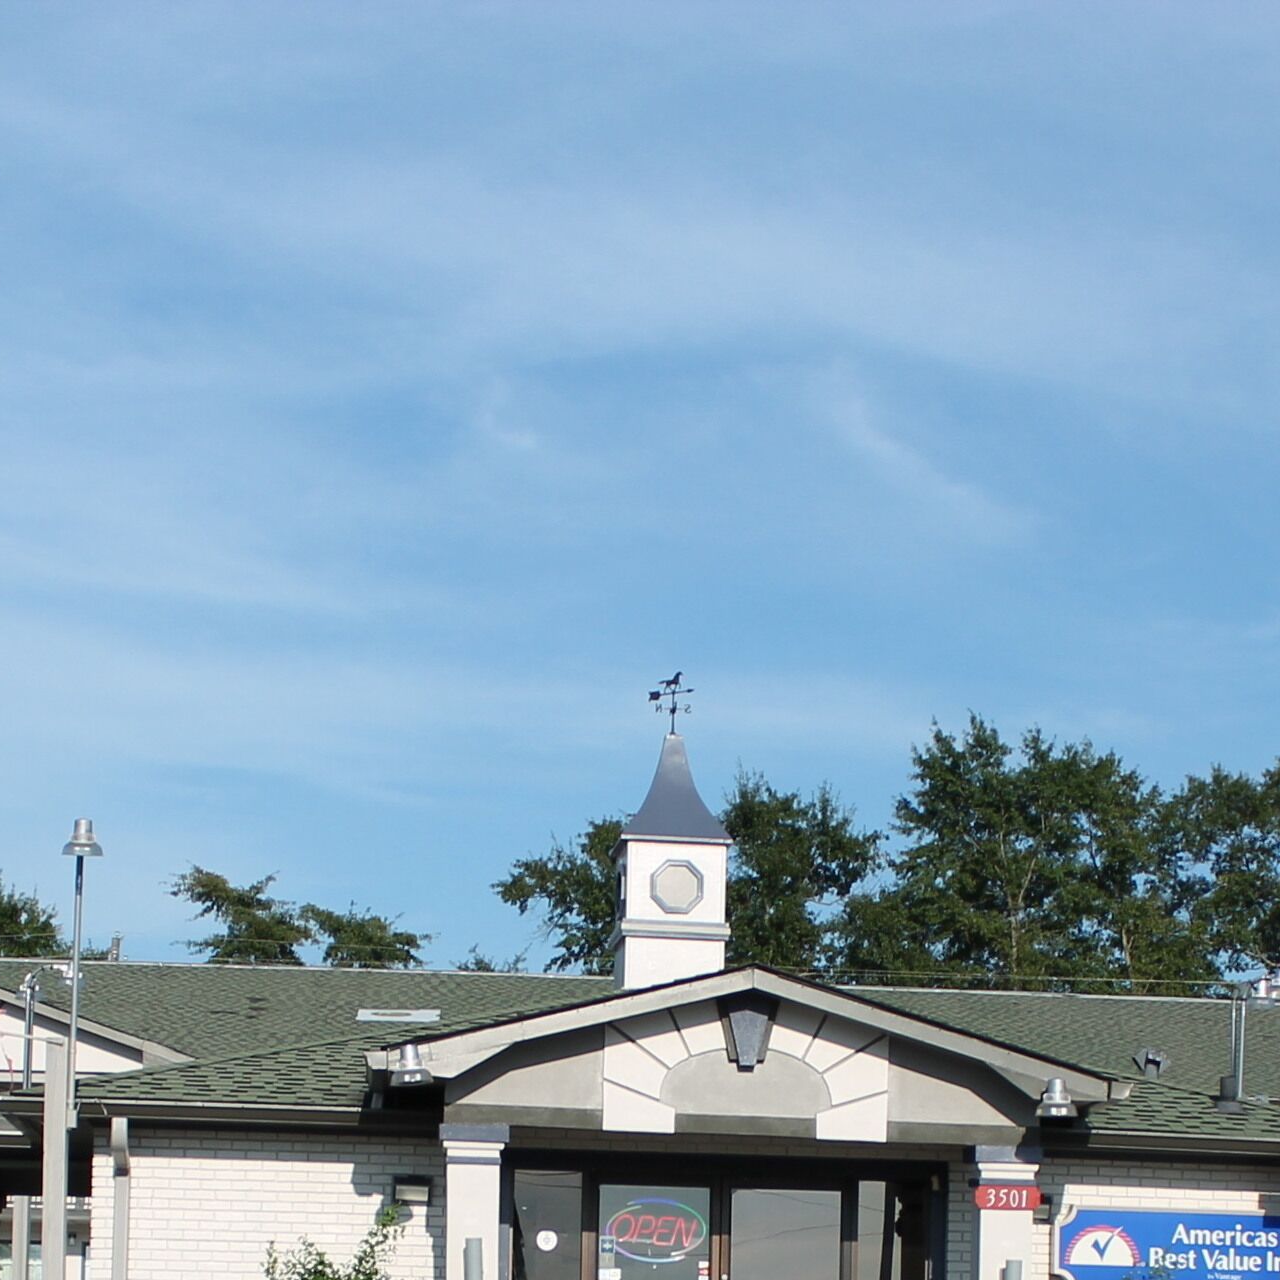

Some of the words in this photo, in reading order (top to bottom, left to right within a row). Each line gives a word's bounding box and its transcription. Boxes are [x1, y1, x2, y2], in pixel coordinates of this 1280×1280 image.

[986, 1188, 1027, 1208] 3501
[612, 1213, 698, 1247] OPEN
[1171, 1223, 1279, 1248] Americas
[1149, 1247, 1197, 1270] Best
[1202, 1248, 1263, 1272] Value
